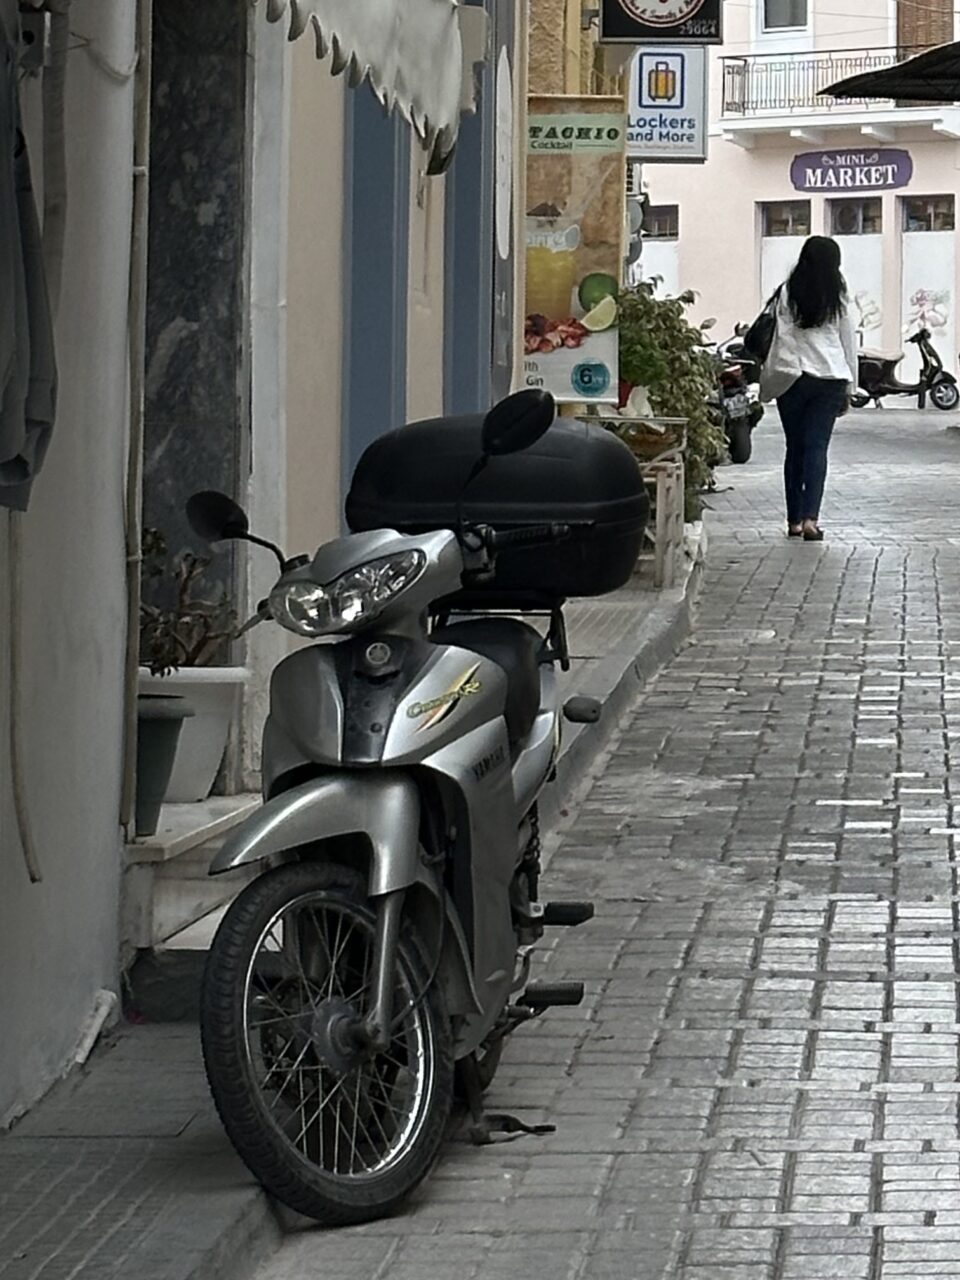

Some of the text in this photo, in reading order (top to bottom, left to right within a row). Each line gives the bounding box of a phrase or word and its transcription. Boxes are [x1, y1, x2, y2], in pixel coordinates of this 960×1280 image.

[627, 112, 696, 130] Lockers
[626, 130, 696, 143] and More
[530, 140, 574, 150] Cocktail
[835, 153, 866, 166] MINI
[803, 164, 898, 188] MARKET
[526, 374, 544, 387] Gin
